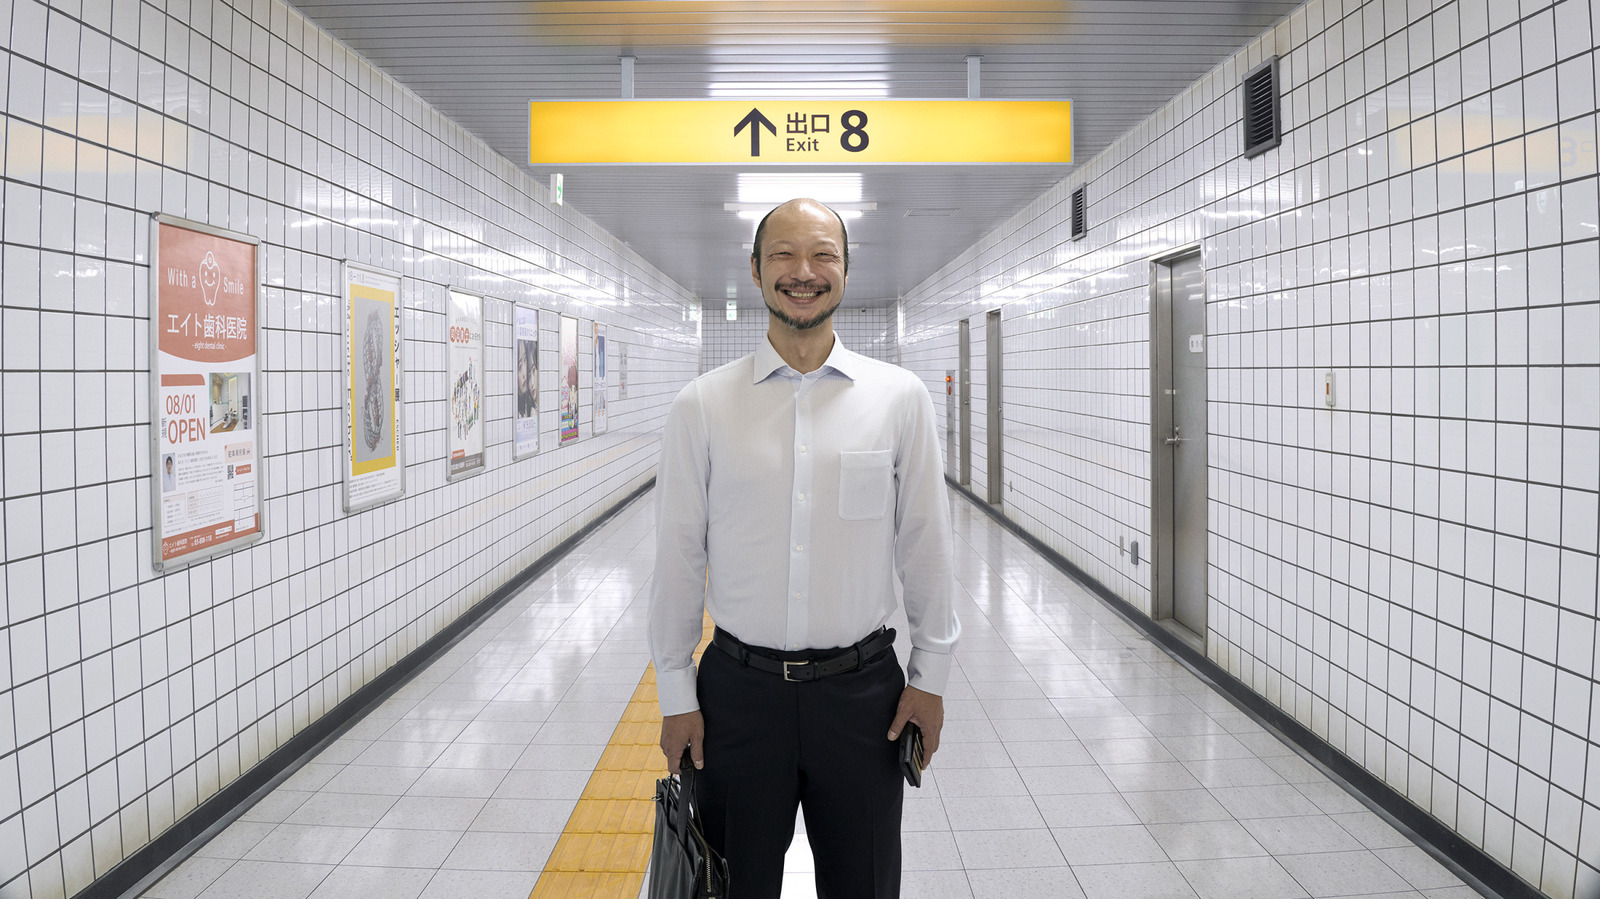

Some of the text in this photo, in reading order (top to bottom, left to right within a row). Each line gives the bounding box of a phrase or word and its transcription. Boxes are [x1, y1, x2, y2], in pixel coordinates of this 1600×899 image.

[786, 109, 870, 153] 出口 8
[786, 137, 820, 152] Exit
[167, 267, 244, 295] With a Smile
[167, 312, 248, 340] エイト歯科医院
[166, 393, 196, 415] 08/01
[168, 417, 206, 445] OPEN
